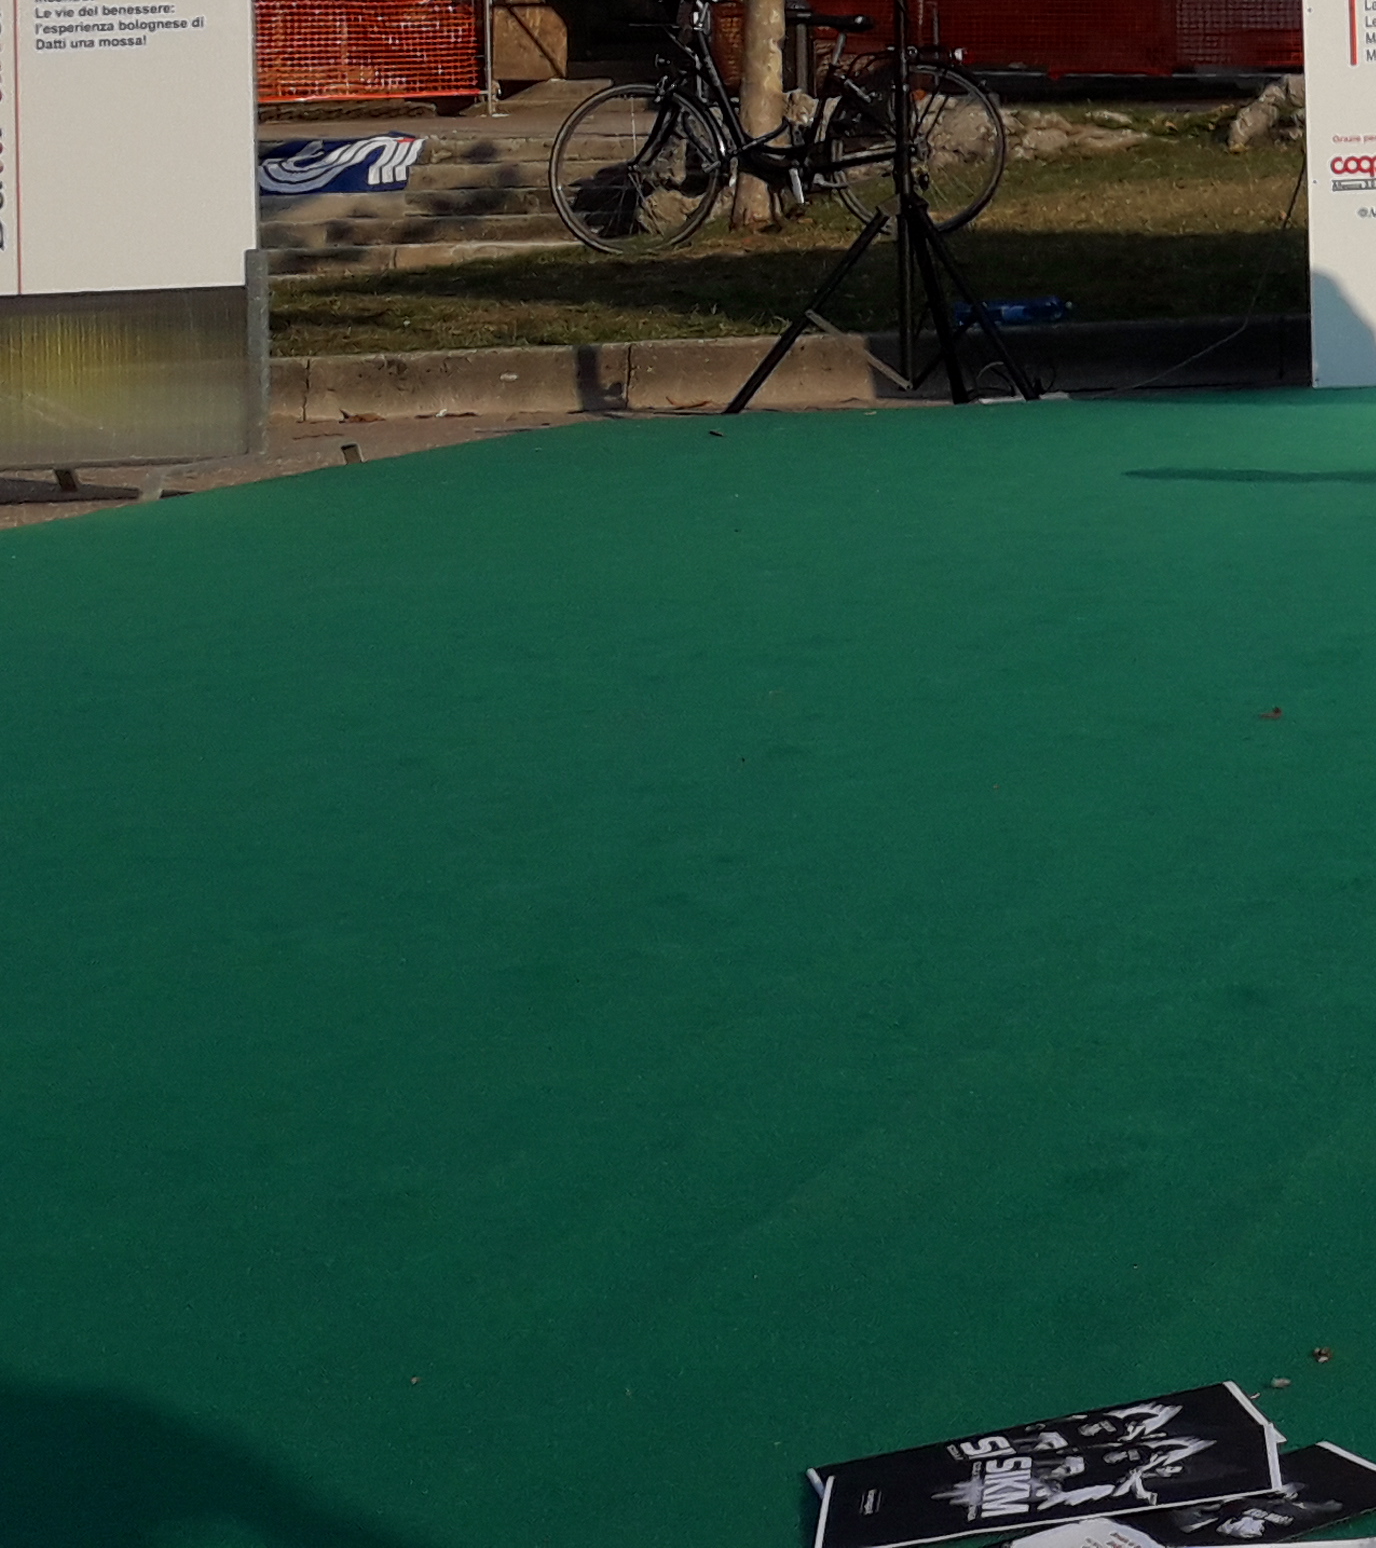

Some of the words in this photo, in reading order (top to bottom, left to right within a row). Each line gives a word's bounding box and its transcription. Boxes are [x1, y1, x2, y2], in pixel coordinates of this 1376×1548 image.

[35, 8, 51, 18] Le
[55, 7, 74, 18] vie
[78, 6, 98, 17] del
[118, 19, 188, 32] bolognese
[191, 16, 204, 28] di
[36, 38, 66, 50] Datti
[70, 39, 95, 49] una
[98, 35, 147, 47] mossa!
